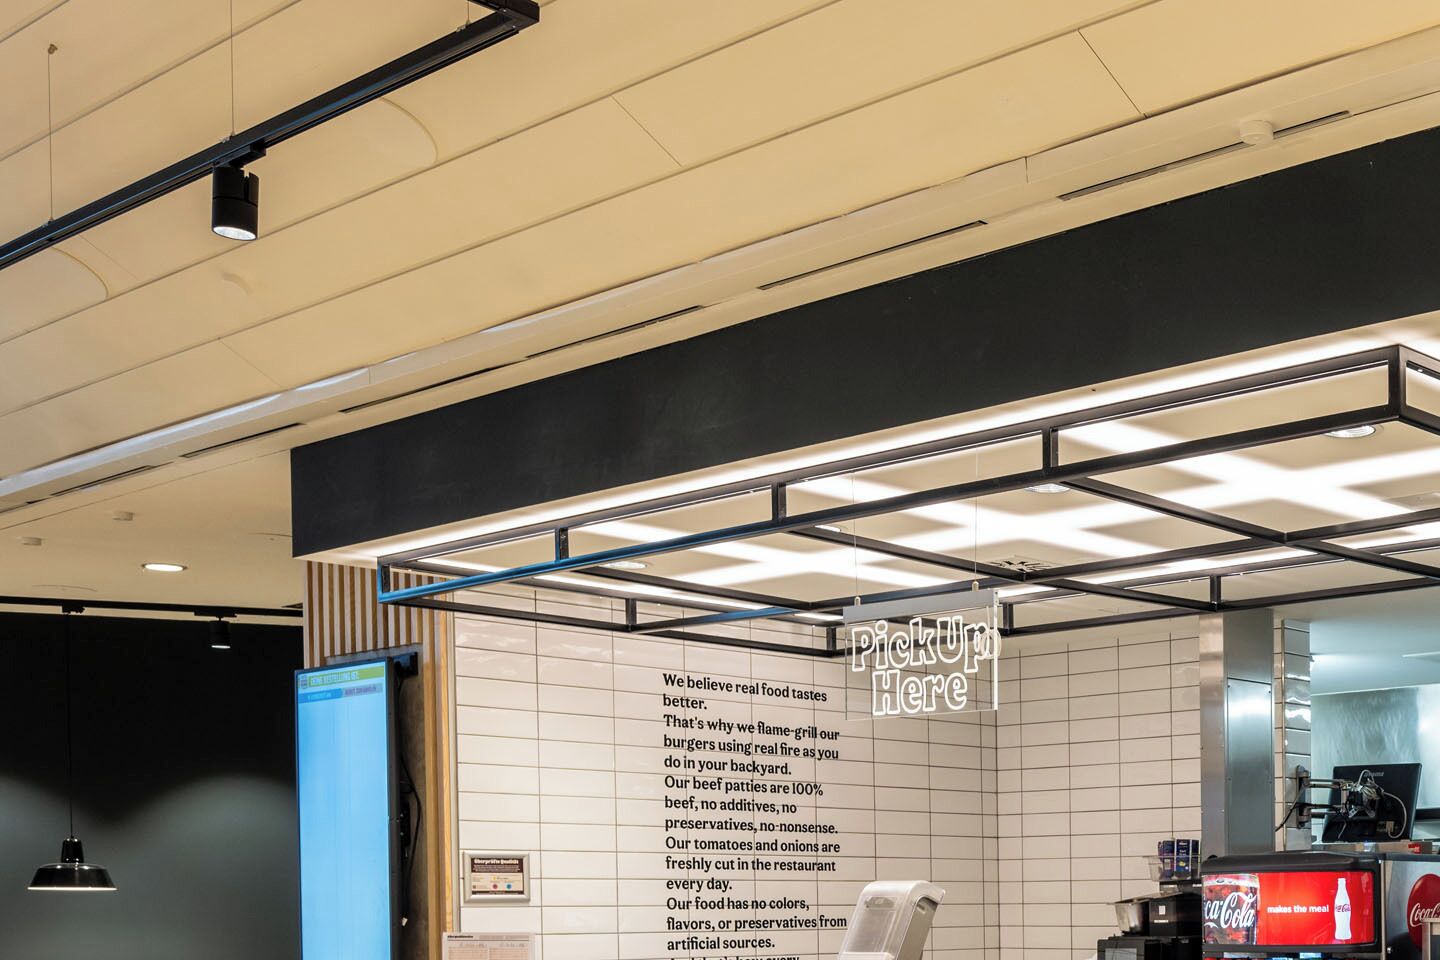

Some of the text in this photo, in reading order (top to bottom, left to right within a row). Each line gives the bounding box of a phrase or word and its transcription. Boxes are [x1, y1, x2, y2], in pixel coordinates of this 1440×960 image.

[663, 674, 827, 701] We believe real food tastes
[872, 669, 968, 716] Here
[663, 694, 707, 709] better.
[707, 719, 733, 734] why
[737, 724, 754, 733] we
[758, 721, 817, 740] flame-grill
[820, 731, 839, 740] our
[664, 735, 838, 760] burgers using real fire as you
[665, 755, 792, 776] do in your backyard.
[665, 776, 824, 796] Our beef patties are 100%
[665, 796, 797, 814] beef, no additives, no
[666, 820, 838, 833] preservatives, no-nonsense.
[666, 837, 840, 852] Our tomatoes and onions are
[666, 856, 835, 872] freshly cut in the restaurant
[667, 878, 733, 892] every day.
[667, 897, 809, 911] Our food has no colors,
[667, 915, 847, 932] flavors, or preservatives from
[668, 937, 774, 950] artificial sources.
